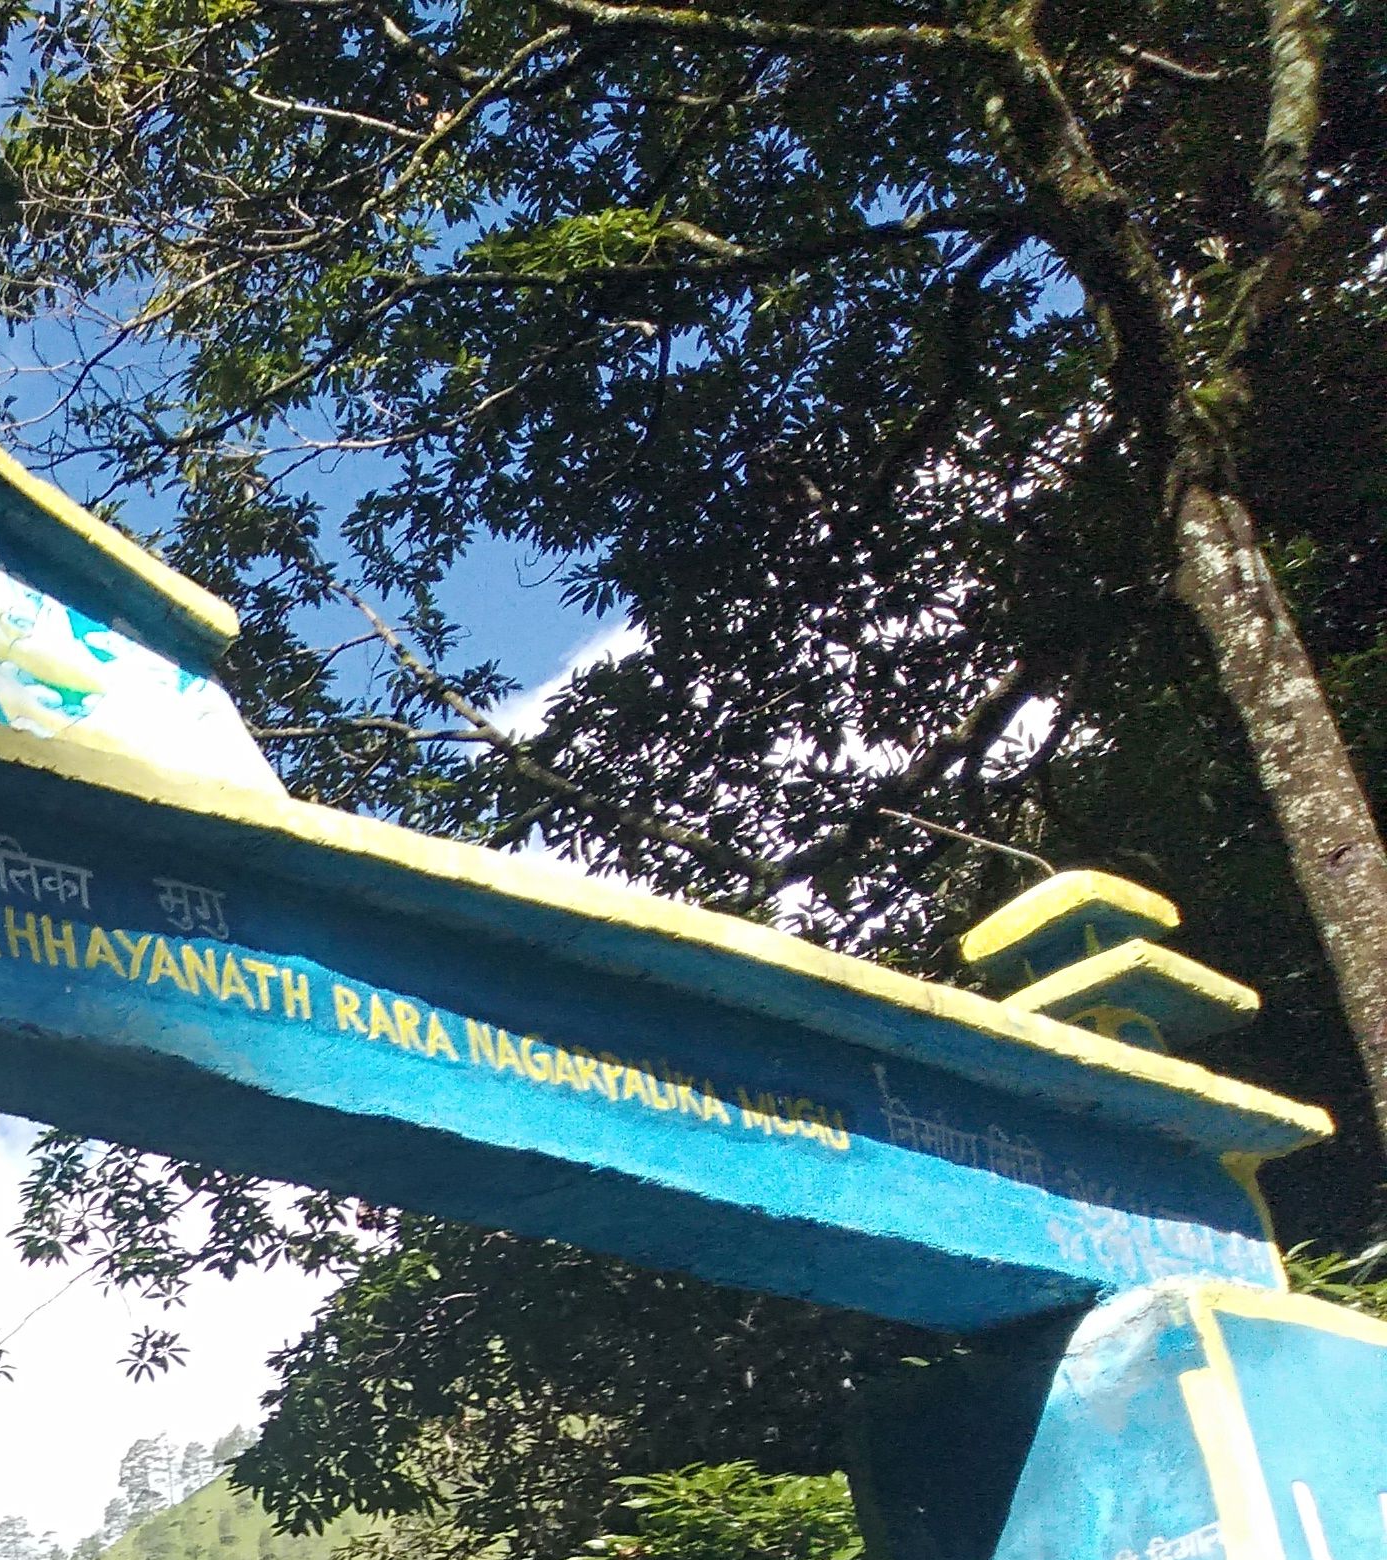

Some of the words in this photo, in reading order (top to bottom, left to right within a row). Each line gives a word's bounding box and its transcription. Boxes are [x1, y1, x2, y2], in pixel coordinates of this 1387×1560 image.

[153, 876, 230, 941] मुगु
[332, 984, 460, 1063] RARA
[464, 1017, 732, 1126] NAGARPALIKA
[736, 1086, 852, 1151] MUGU
